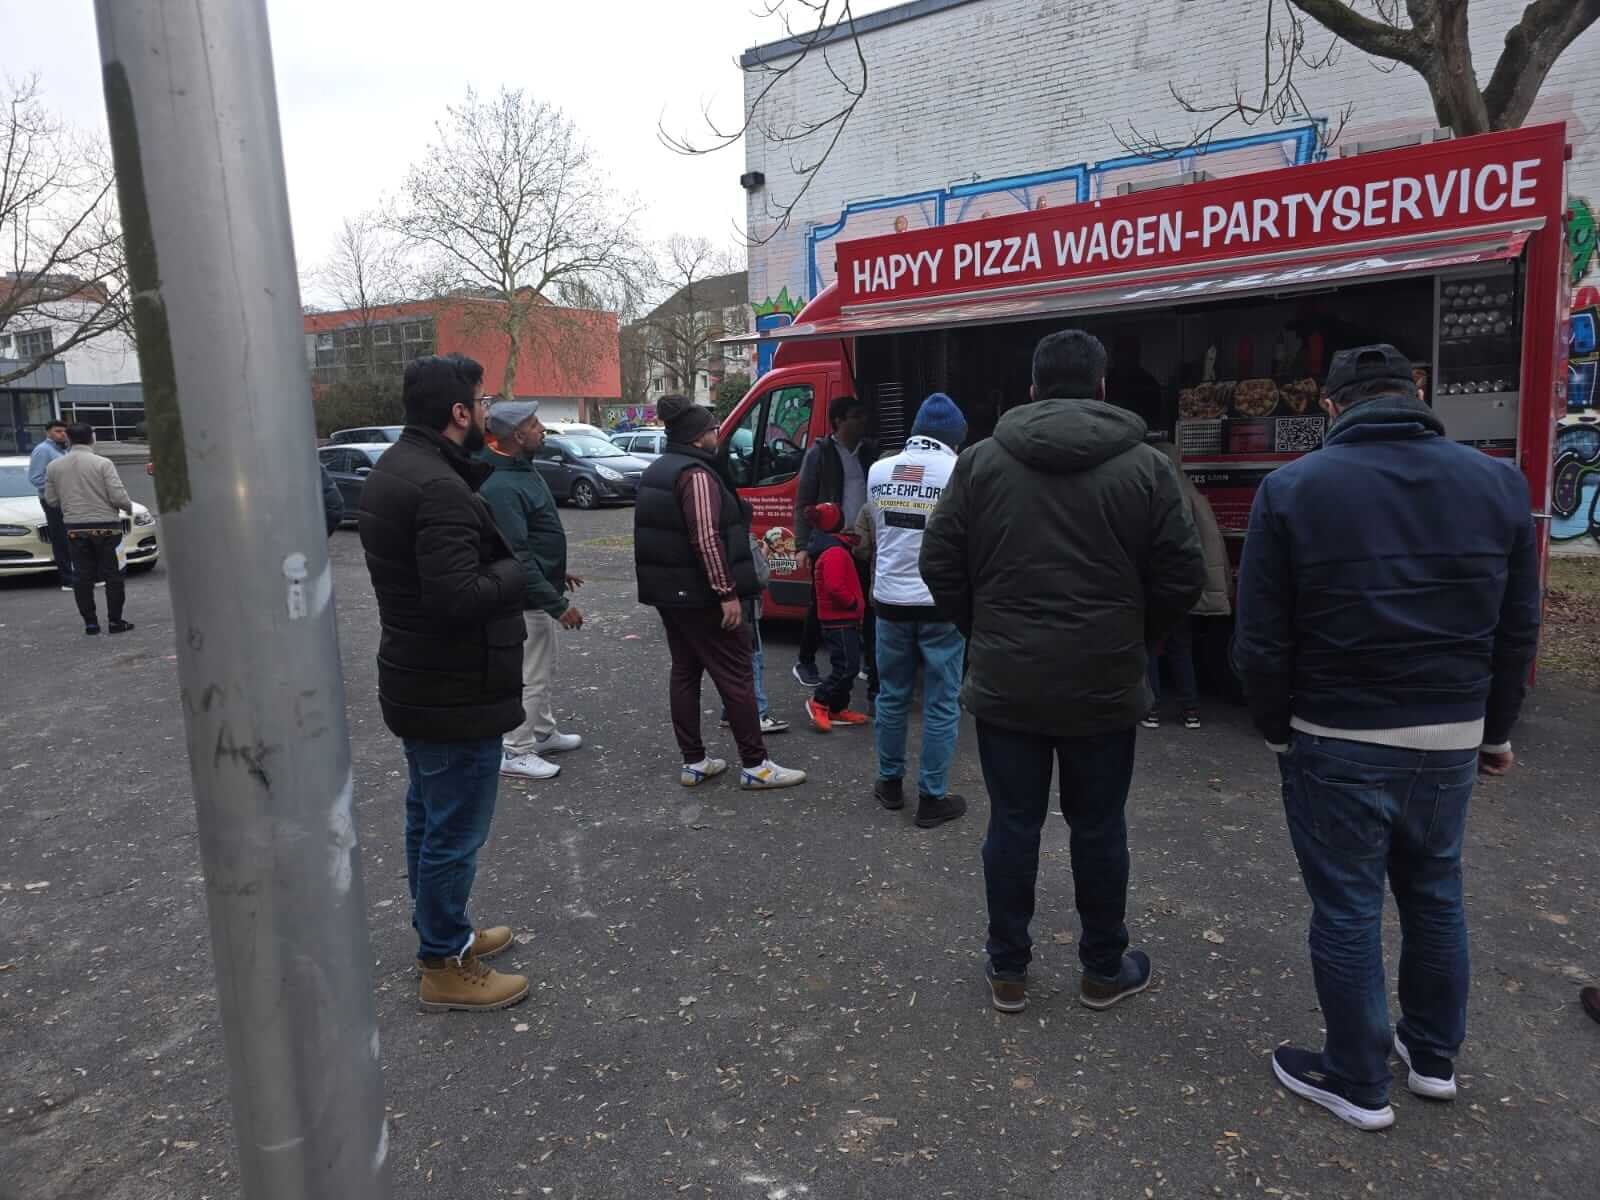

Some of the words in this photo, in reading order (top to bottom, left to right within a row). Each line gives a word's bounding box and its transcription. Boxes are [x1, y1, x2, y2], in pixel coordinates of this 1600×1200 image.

[853, 249, 943, 294] HAPYY
[954, 233, 1042, 281] PIZZA
[1053, 158, 1541, 267] WAGEN-PARTYSERVICE
